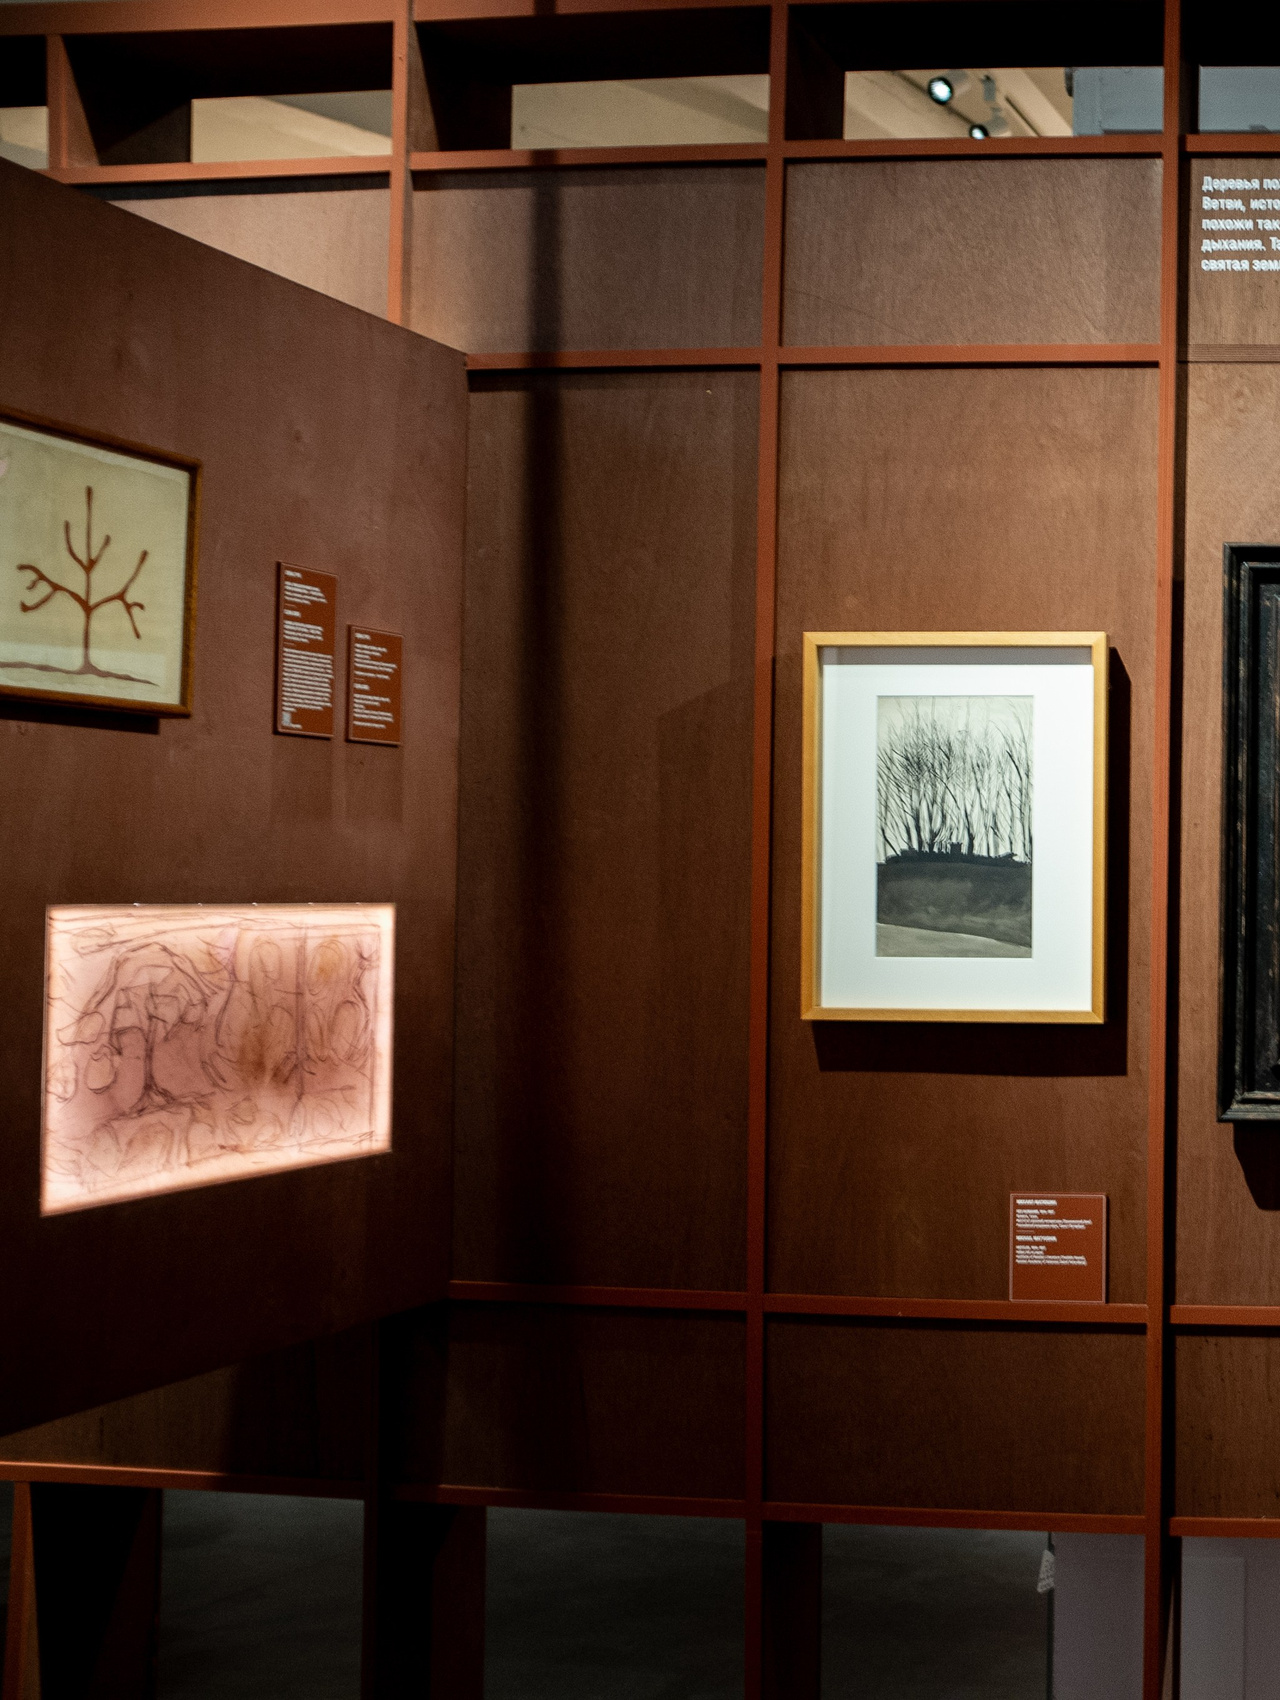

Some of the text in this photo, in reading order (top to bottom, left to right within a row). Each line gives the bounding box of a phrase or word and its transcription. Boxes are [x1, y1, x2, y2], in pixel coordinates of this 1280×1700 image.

[1201, 176, 1261, 193] Деревья
[1201, 196, 1246, 212] Ветви,
[1201, 219, 1254, 230] похожи
[1255, 219, 1280, 230] так
[1200, 239, 1267, 253] дыхания.
[1200, 260, 1250, 271] святая
